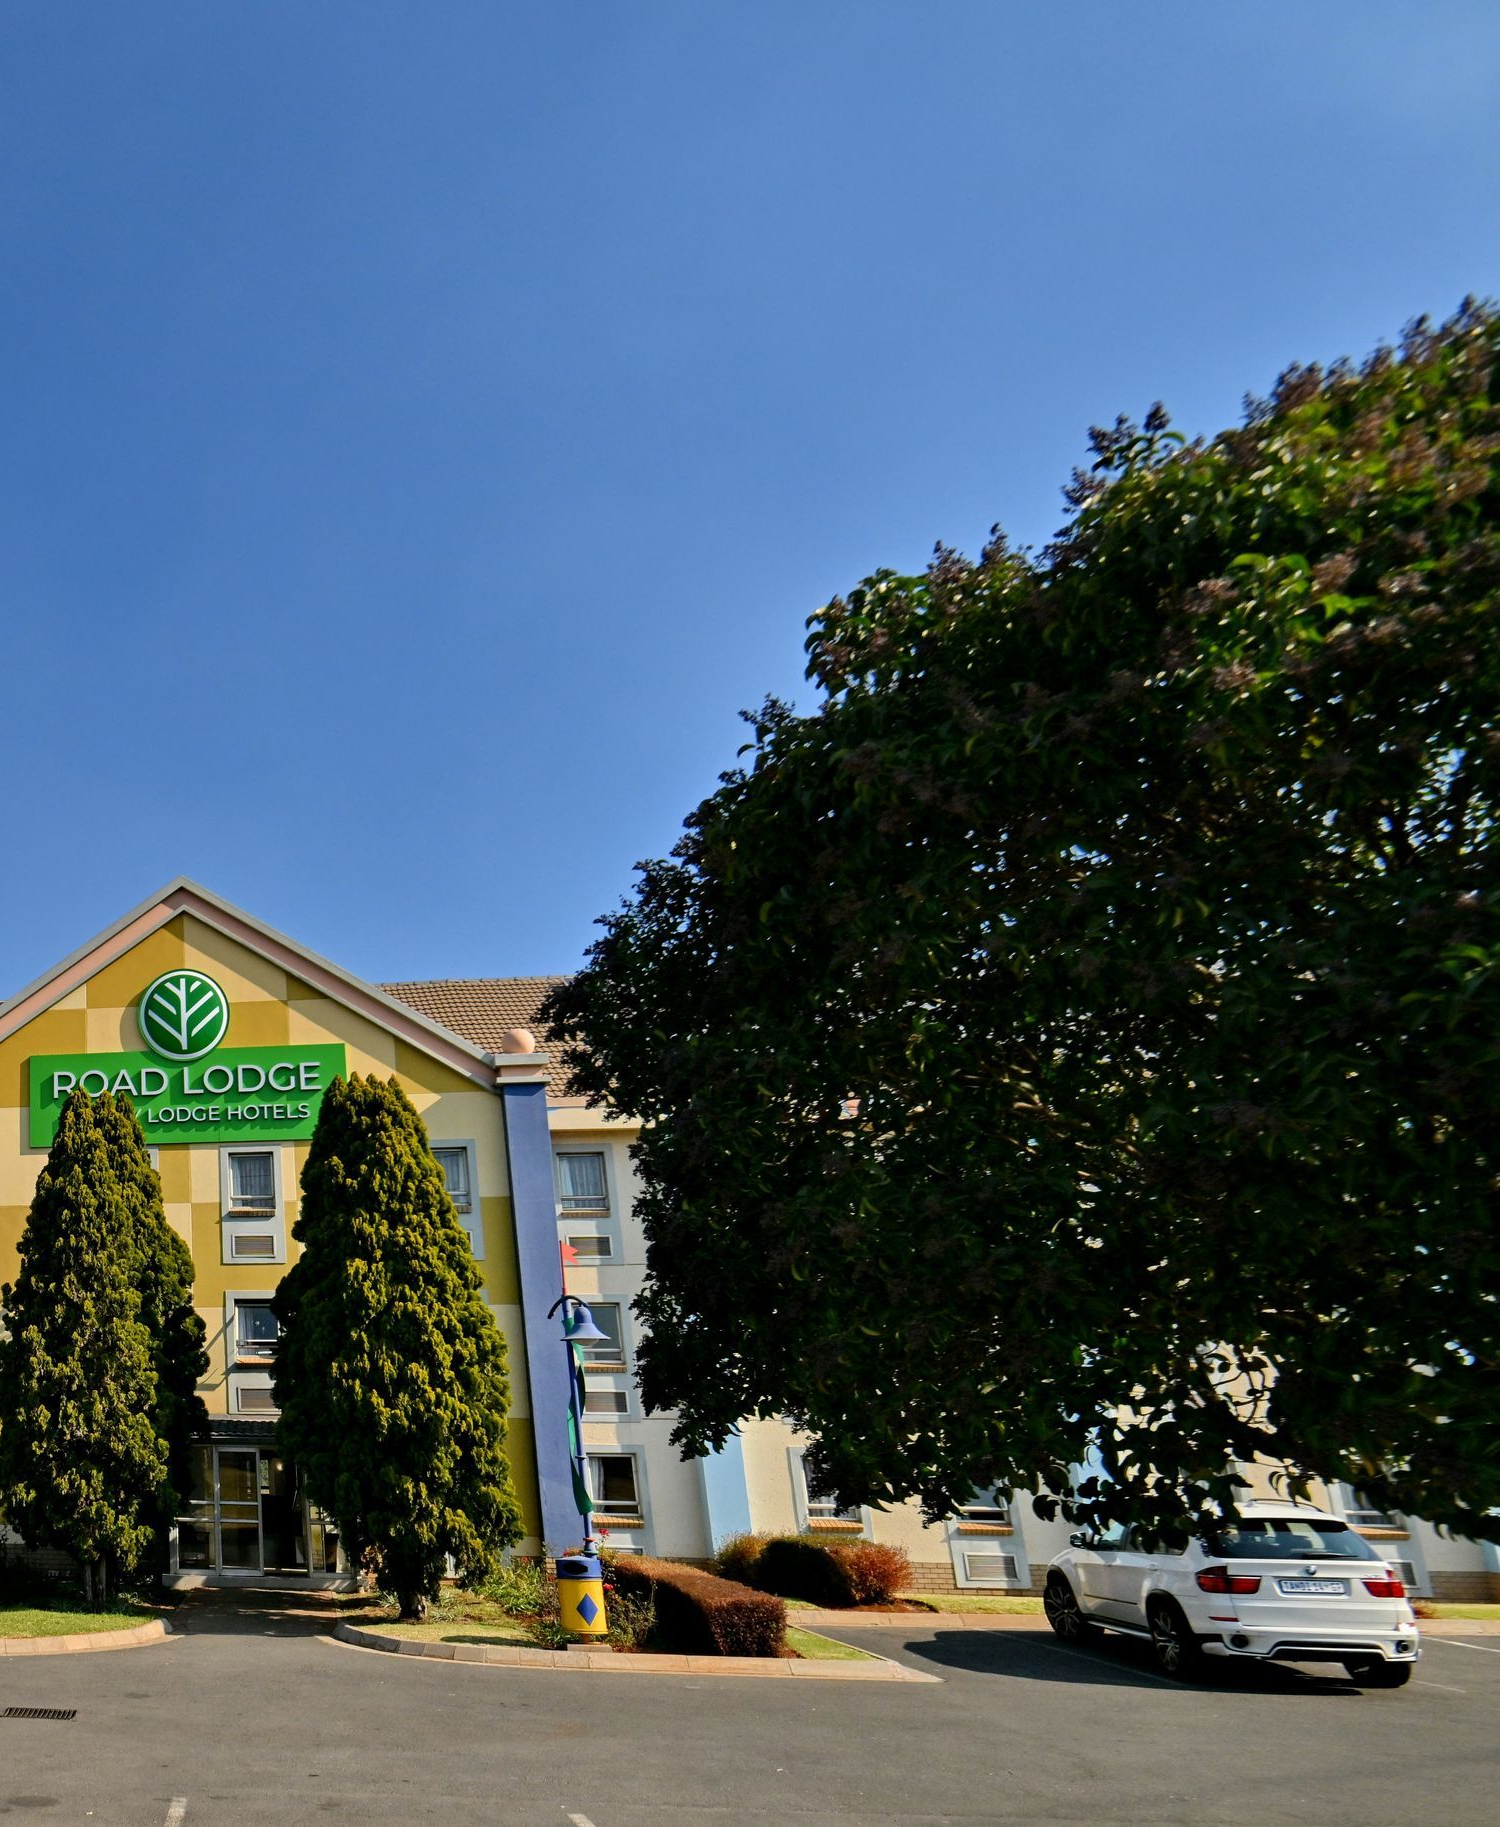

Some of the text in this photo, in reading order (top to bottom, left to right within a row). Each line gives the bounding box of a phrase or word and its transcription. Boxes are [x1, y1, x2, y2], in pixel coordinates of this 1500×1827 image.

[53, 1061, 322, 1098] ROAD LODGE
[148, 1106, 220, 1122] LODGE
[227, 1103, 310, 1120] HOTELS
